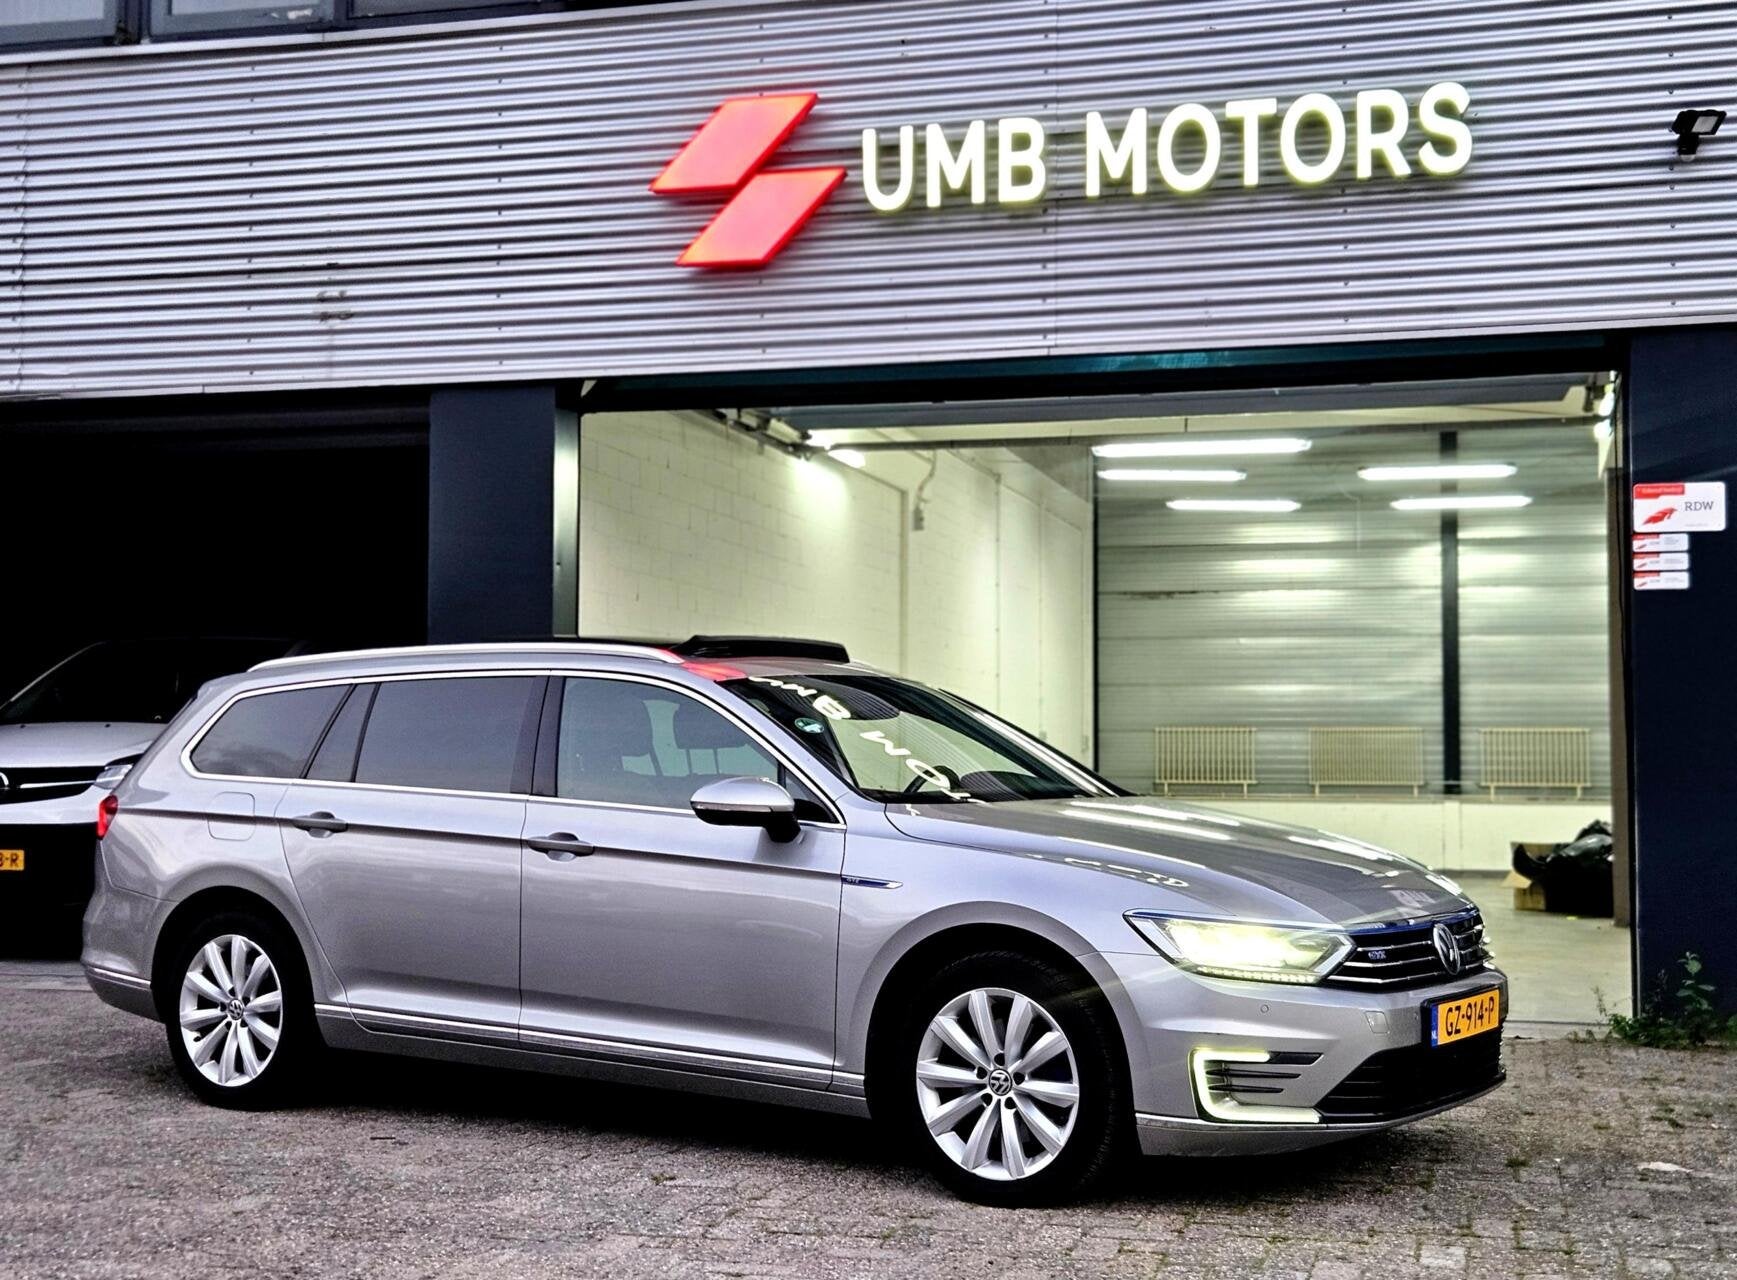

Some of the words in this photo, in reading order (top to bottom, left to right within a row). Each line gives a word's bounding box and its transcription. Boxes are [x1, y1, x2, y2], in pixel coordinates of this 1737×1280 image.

[861, 117, 1047, 211] UMB
[1085, 82, 1474, 197] MOTORS
[1684, 501, 1714, 511] RDW
[1446, 996, 1495, 1037] GZ-914-P
